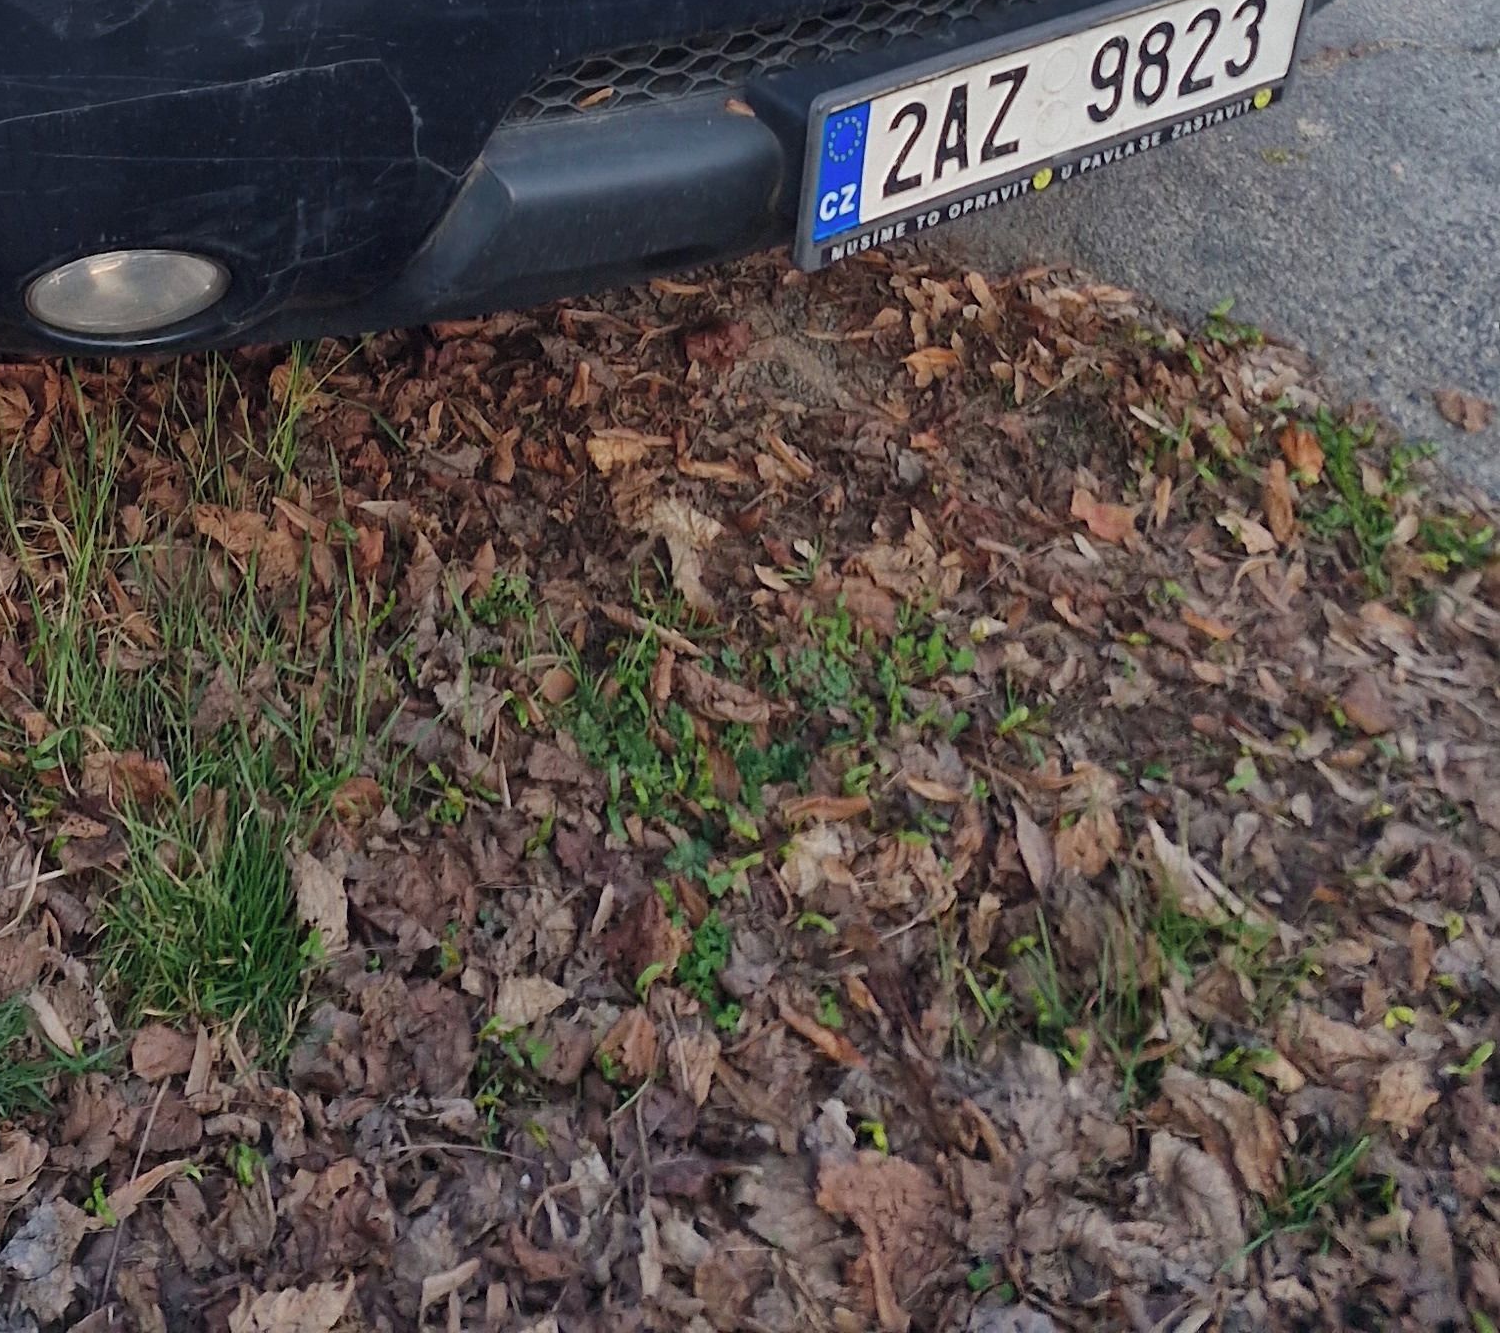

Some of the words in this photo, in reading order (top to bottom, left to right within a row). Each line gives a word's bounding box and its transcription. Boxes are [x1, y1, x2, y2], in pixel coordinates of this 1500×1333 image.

[882, 65, 1029, 198] 2AZ
[1061, 164, 1073, 180] U
[1080, 142, 1135, 173] PAVLA
[1139, 132, 1162, 151] SE
[1171, 98, 1252, 140] ZASTAVIT
[819, 183, 857, 222] CZ
[916, 211, 940, 231] TO
[948, 179, 1031, 220] OPRAVIT
